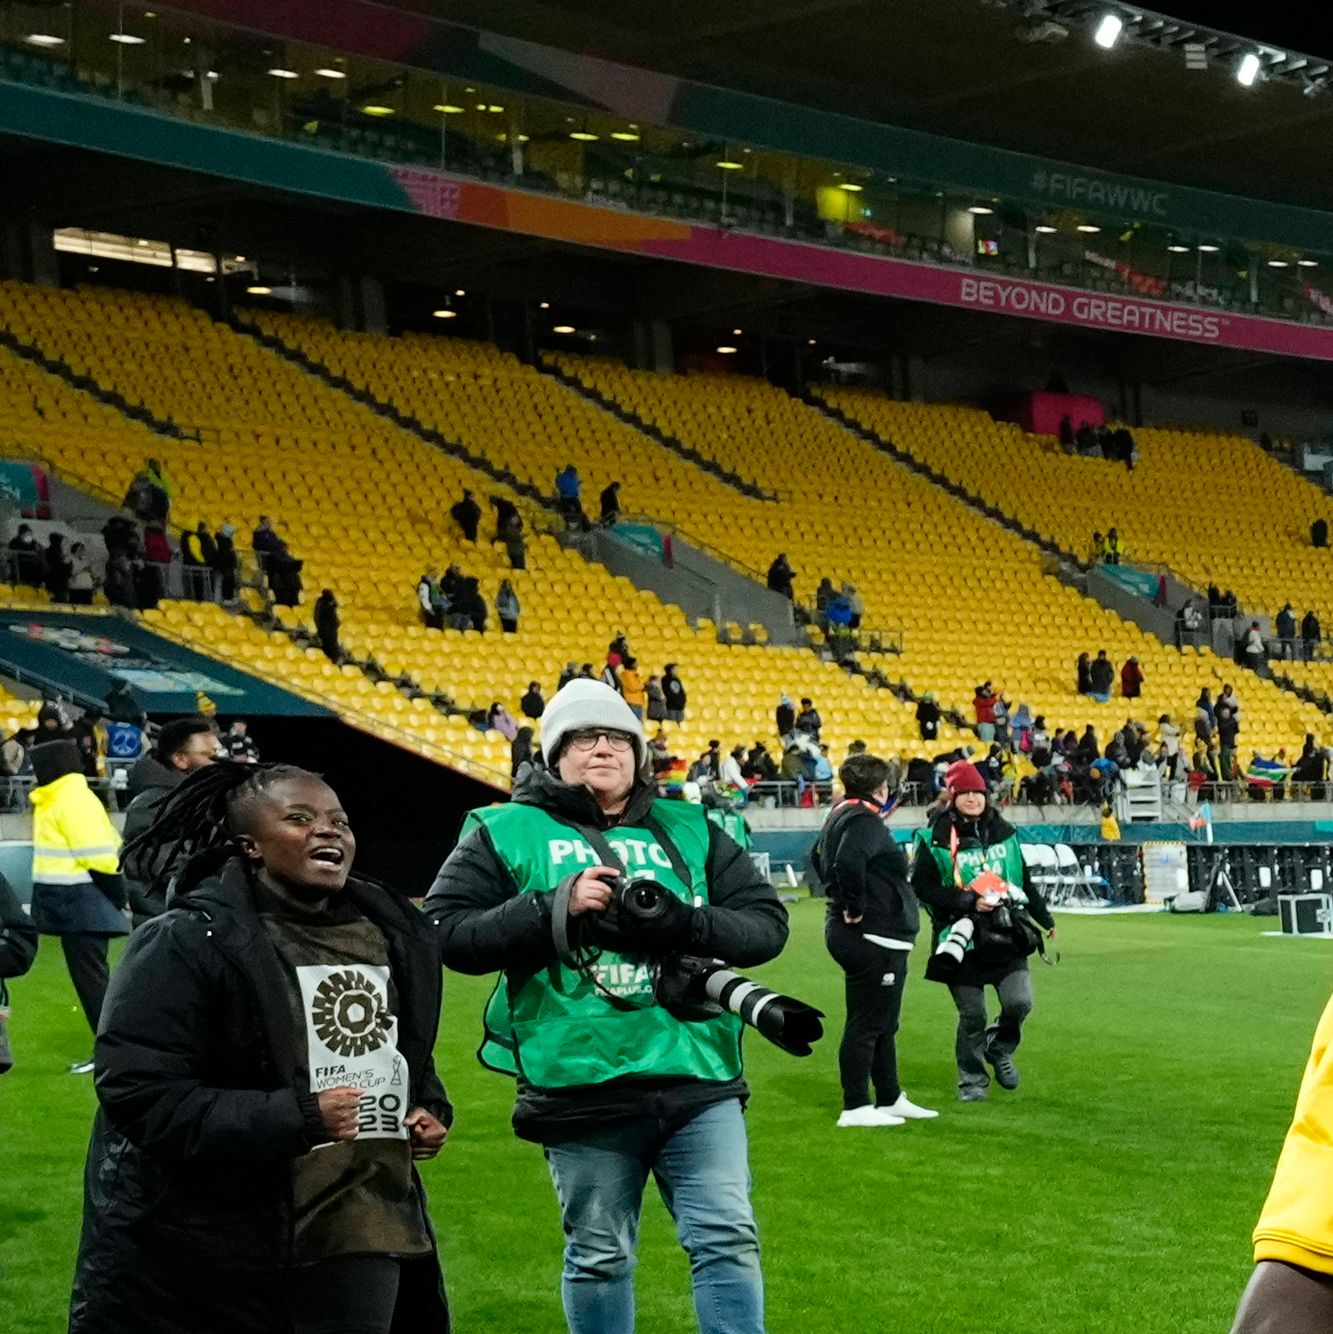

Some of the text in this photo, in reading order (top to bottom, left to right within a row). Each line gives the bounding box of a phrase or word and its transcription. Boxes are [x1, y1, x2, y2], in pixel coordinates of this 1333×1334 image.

[1032, 170, 1170, 215] #FIFAWWC
[961, 278, 1220, 338] BEYOND GREATNESS
[315, 1065, 346, 1078] FIFA
[317, 1069, 374, 1089] WOMEN'S
[359, 1076, 386, 1089] CUP
